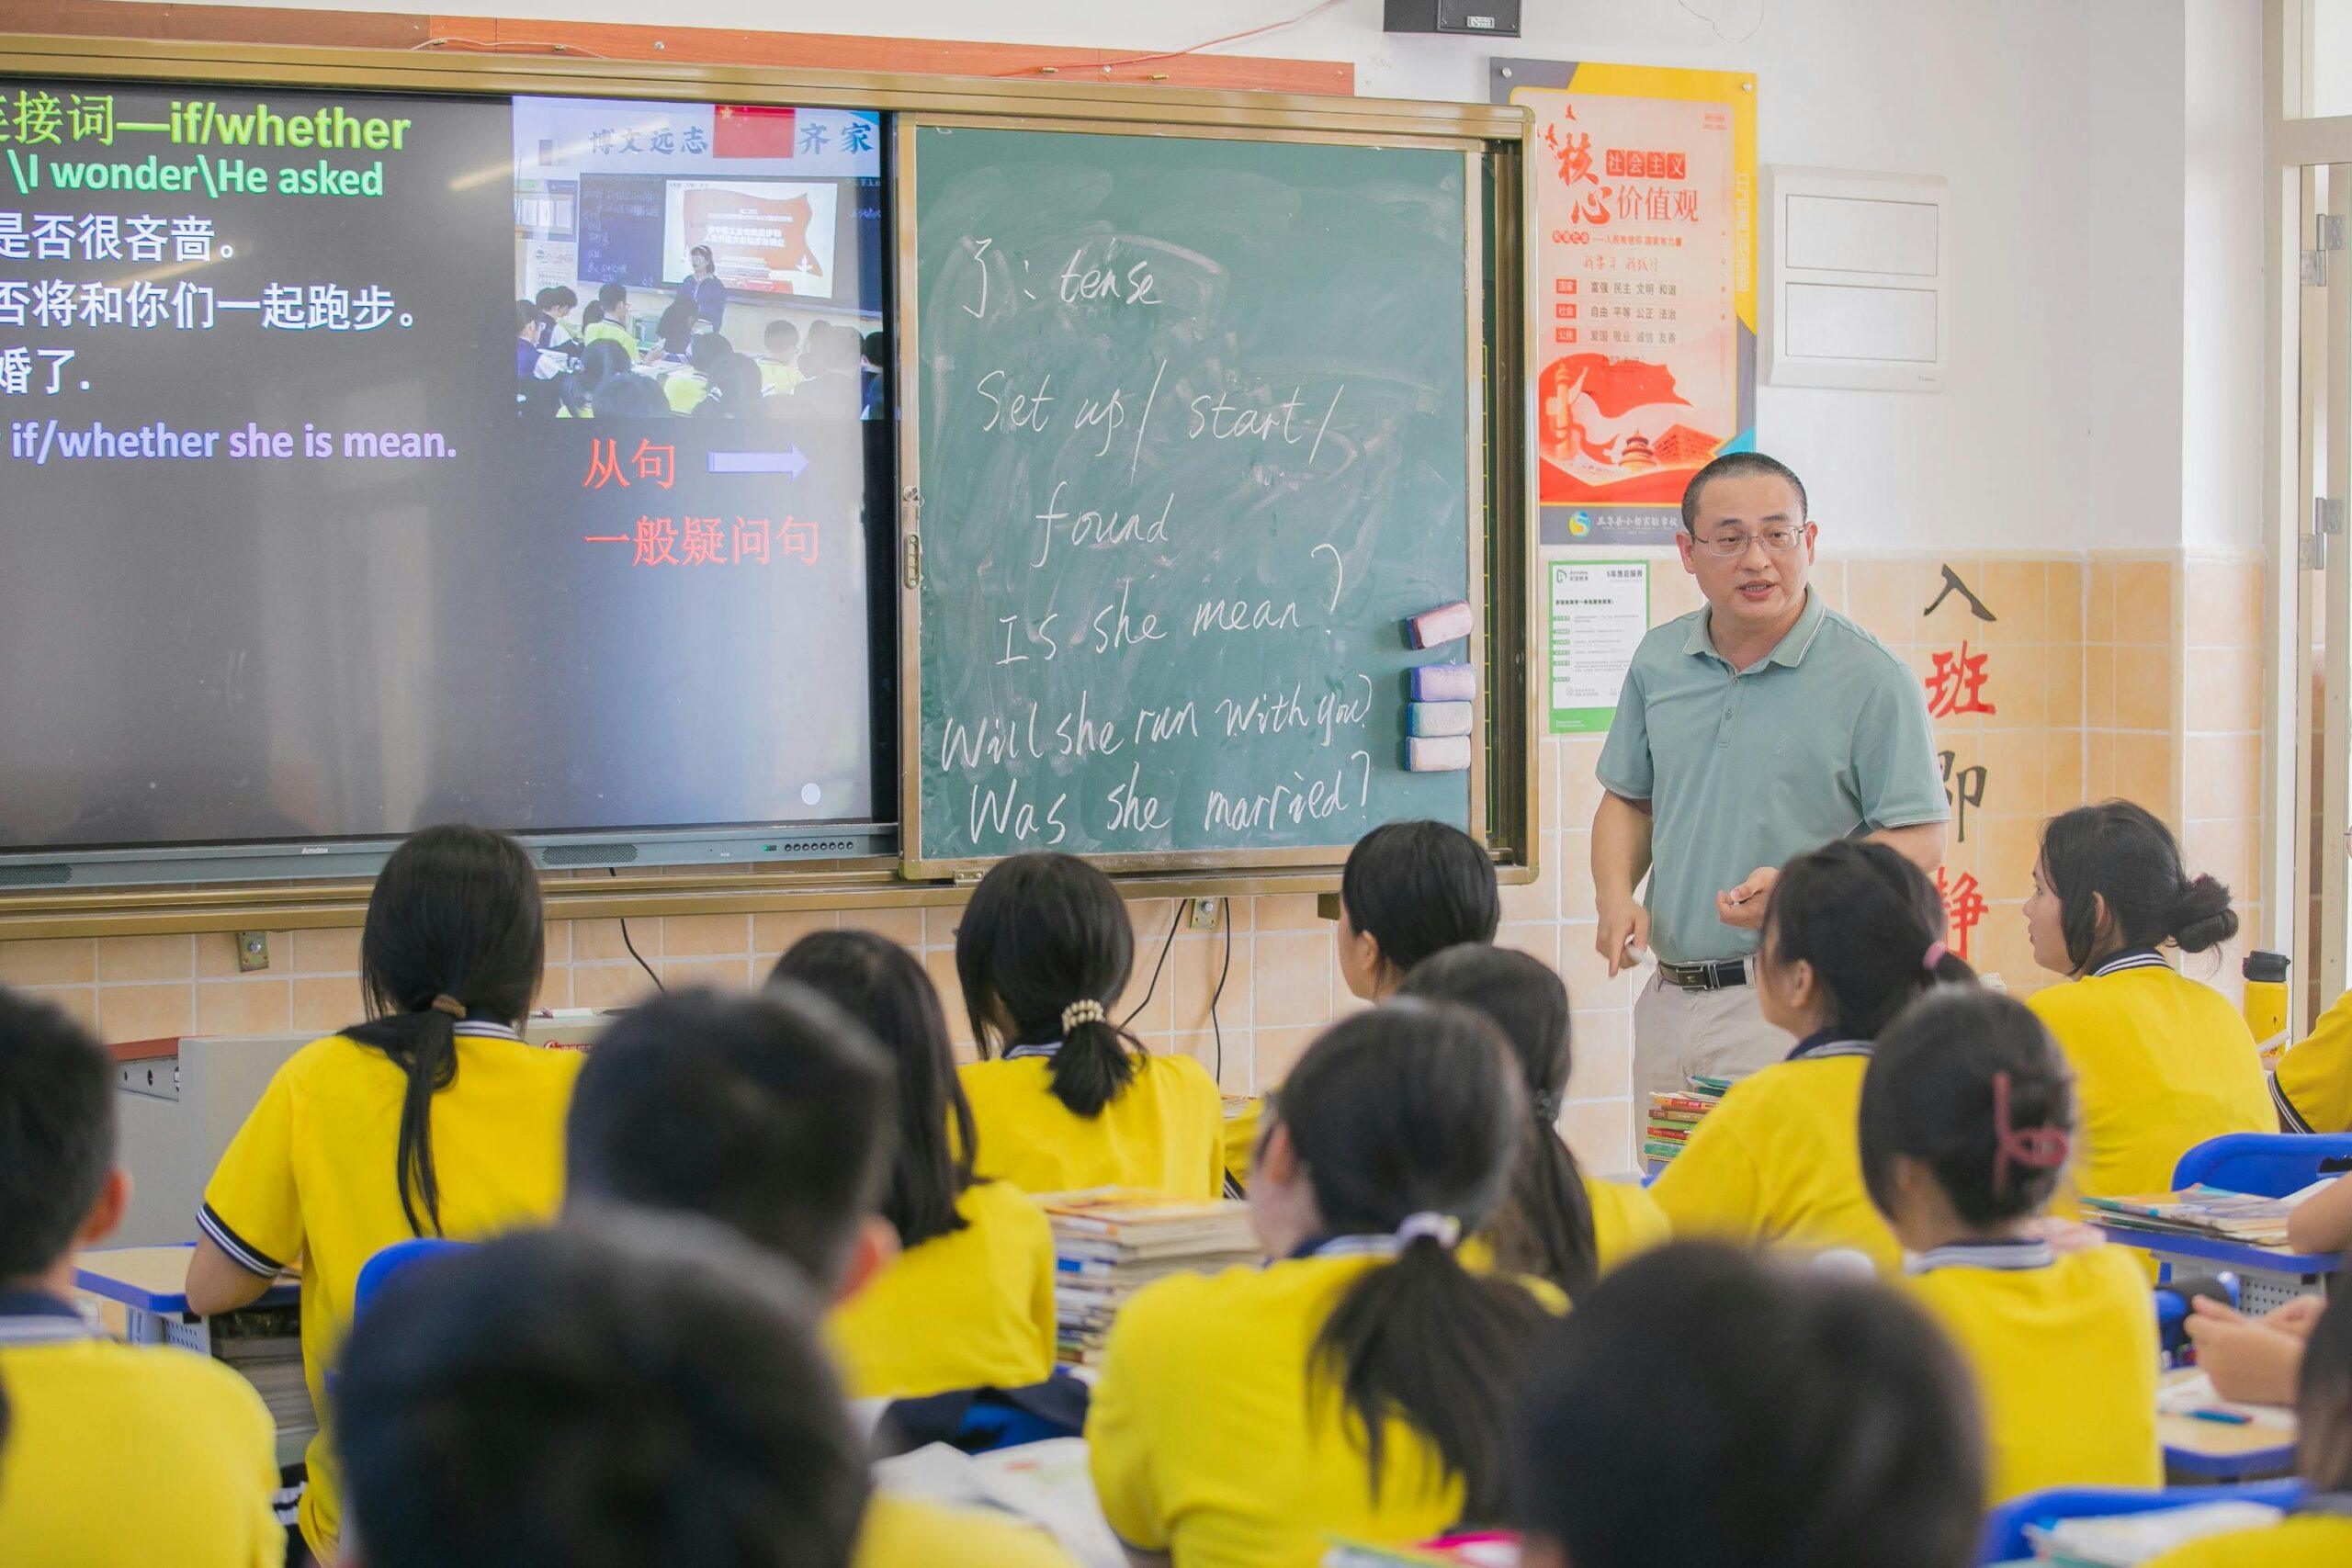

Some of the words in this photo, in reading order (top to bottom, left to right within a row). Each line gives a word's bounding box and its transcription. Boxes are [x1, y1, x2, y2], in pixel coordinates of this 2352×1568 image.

[0, 89, 413, 151] 接词—if/whether
[589, 125, 709, 156] 博文远志
[798, 121, 876, 155] 齐家
[277, 159, 384, 197] asked
[1606, 149, 1686, 180] 社会主义
[1617, 185, 1700, 222] 价值观
[1060, 248, 1164, 304] tense
[1590, 307, 1609, 318] 自由
[1636, 308, 1654, 320] 公正
[977, 369, 1056, 433] Set
[11, 419, 220, 466] if/whether
[228, 422, 294, 458] she
[303, 423, 334, 458] is
[343, 430, 458, 459] mean.
[582, 438, 676, 491] 从句
[584, 514, 820, 567] 一般疑问句
[1029, 480, 1175, 568] found
[1093, 578, 1169, 654] she
[941, 701, 1045, 773] Will
[1056, 689, 1125, 755] she
[1134, 700, 1199, 745] run
[970, 778, 1067, 845] Was
[1106, 761, 1171, 832] she
